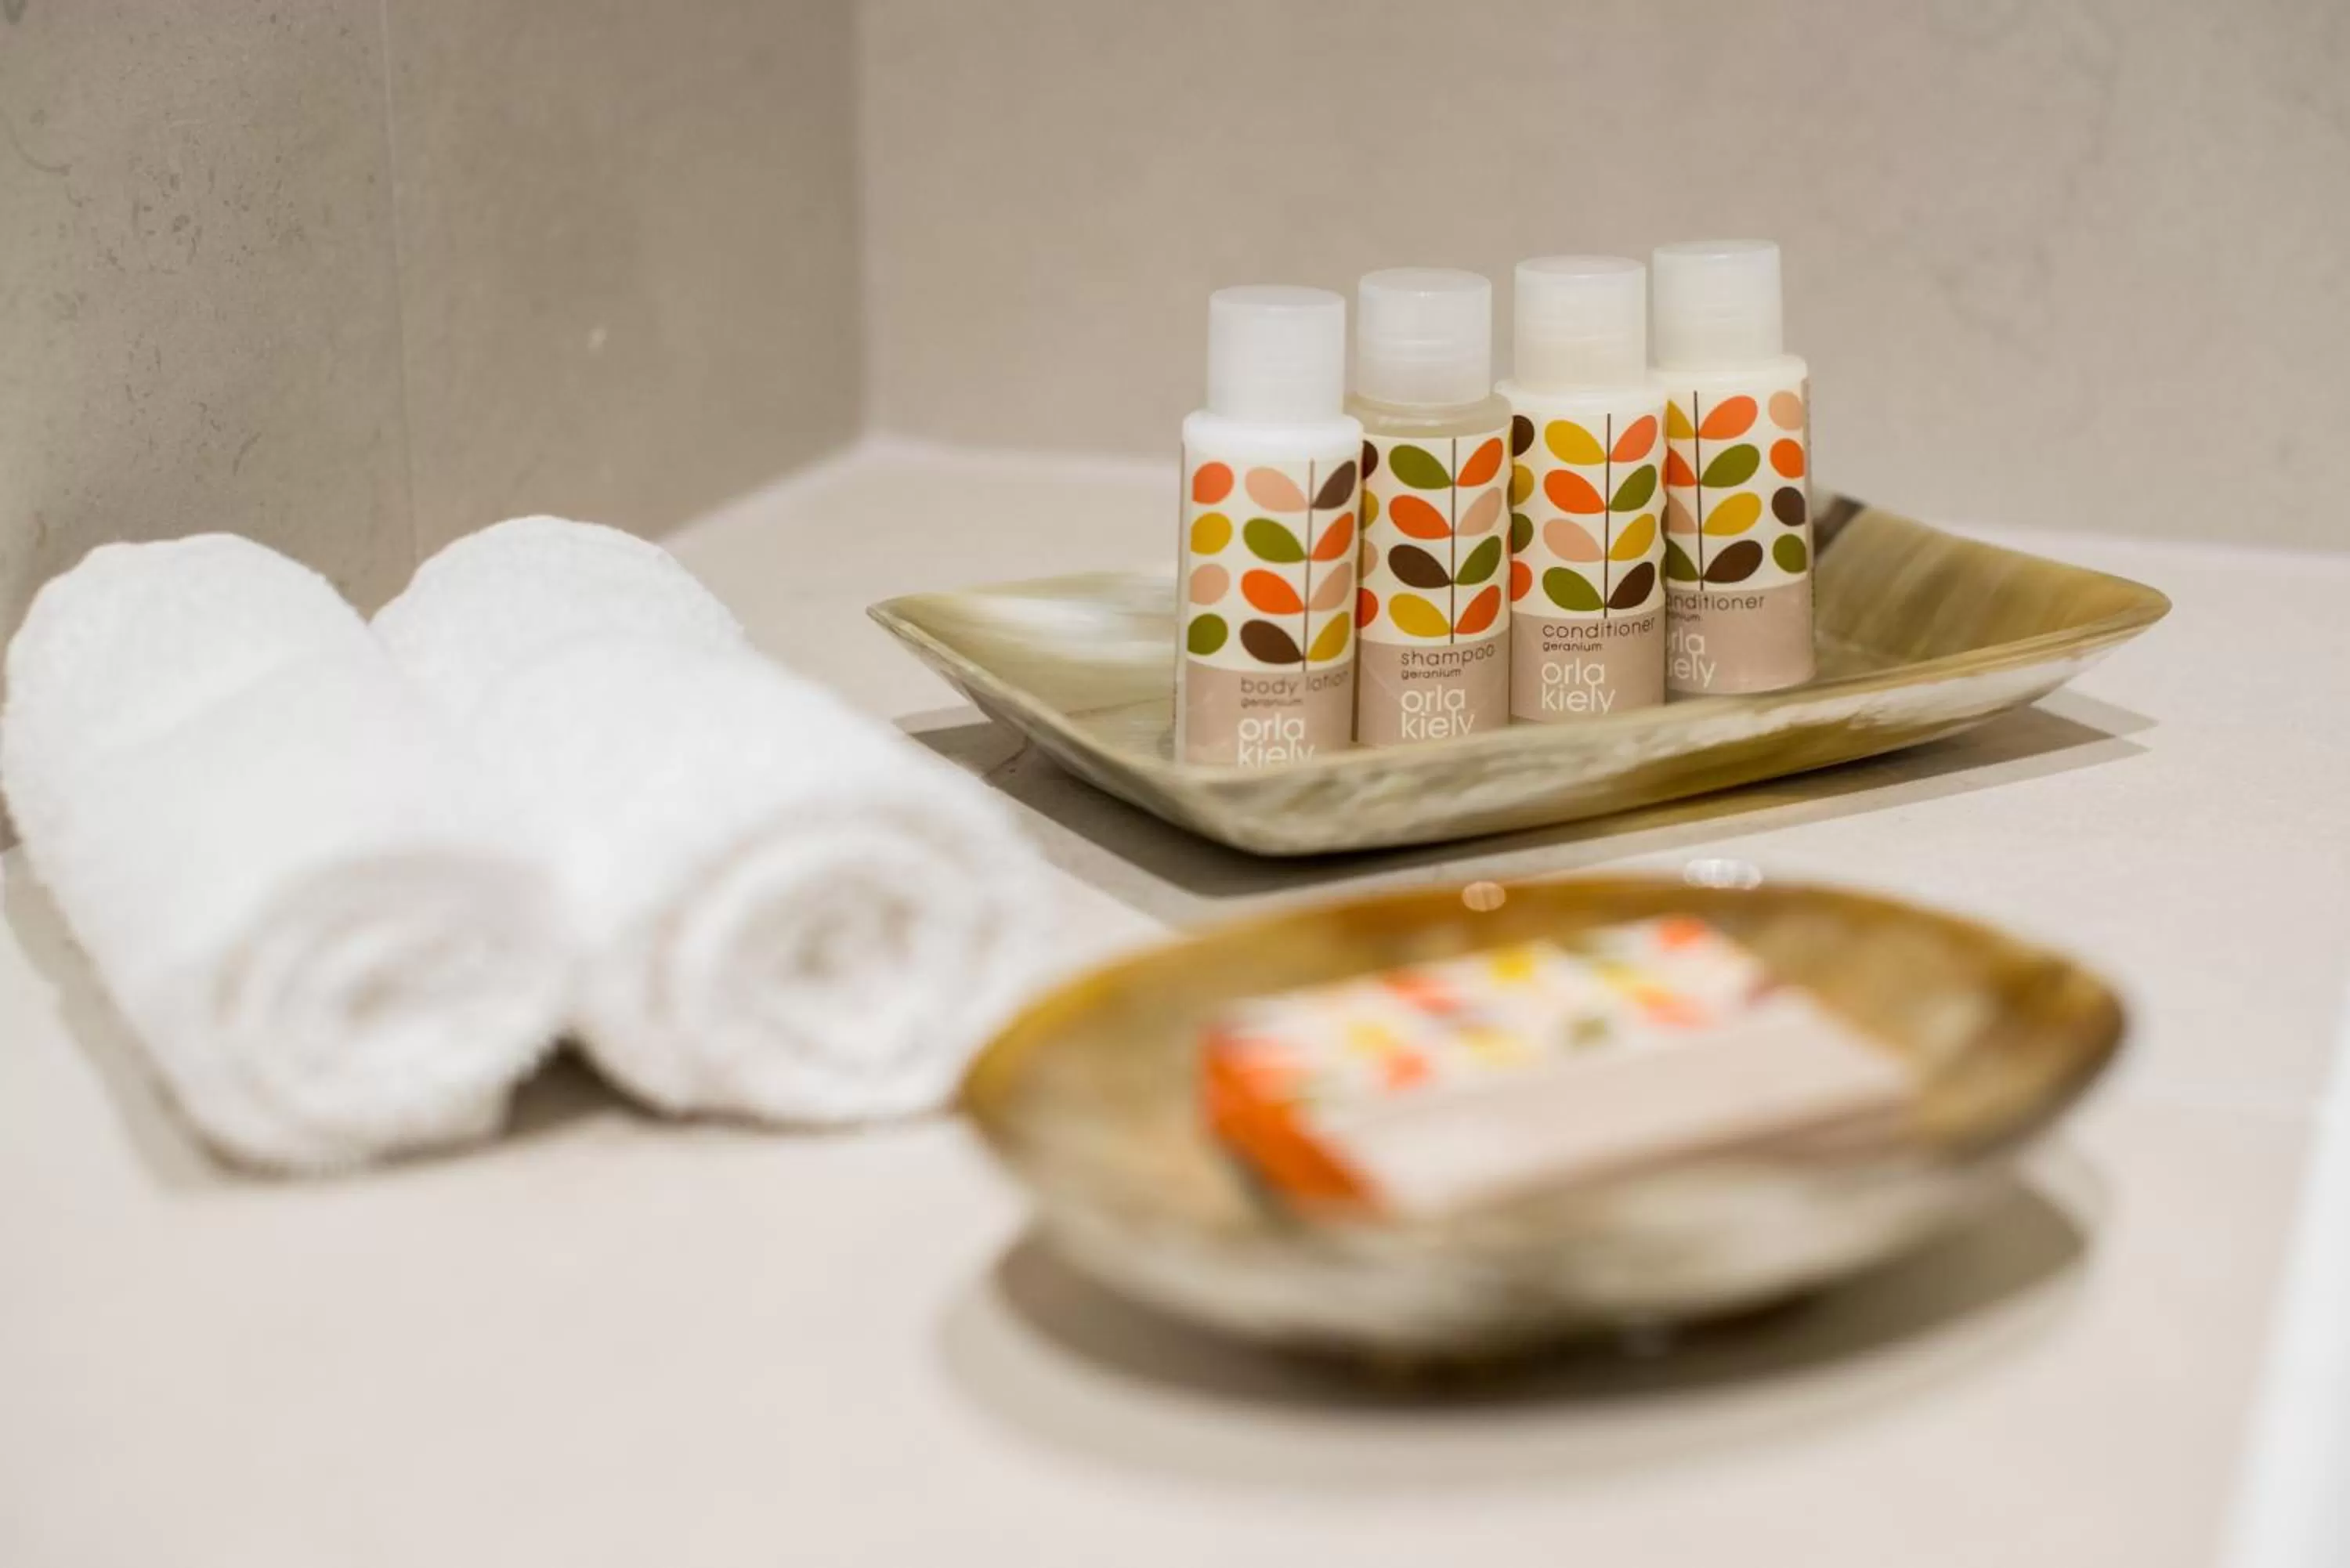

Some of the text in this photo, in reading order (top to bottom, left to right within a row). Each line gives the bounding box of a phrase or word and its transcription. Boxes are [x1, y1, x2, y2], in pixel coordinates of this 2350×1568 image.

[1542, 616, 1655, 639] conditioner
[1667, 626, 1705, 655] rla
[1401, 643, 1495, 667] shampoo
[1542, 641, 1603, 652] geranium
[1401, 668, 1462, 680] geranium
[1541, 657, 1605, 685] orla
[1667, 653, 1717, 688] iely
[1240, 677, 1299, 696] body
[1401, 684, 1466, 713] orla
[1541, 682, 1616, 714] kiely
[1238, 712, 1305, 741] orla
